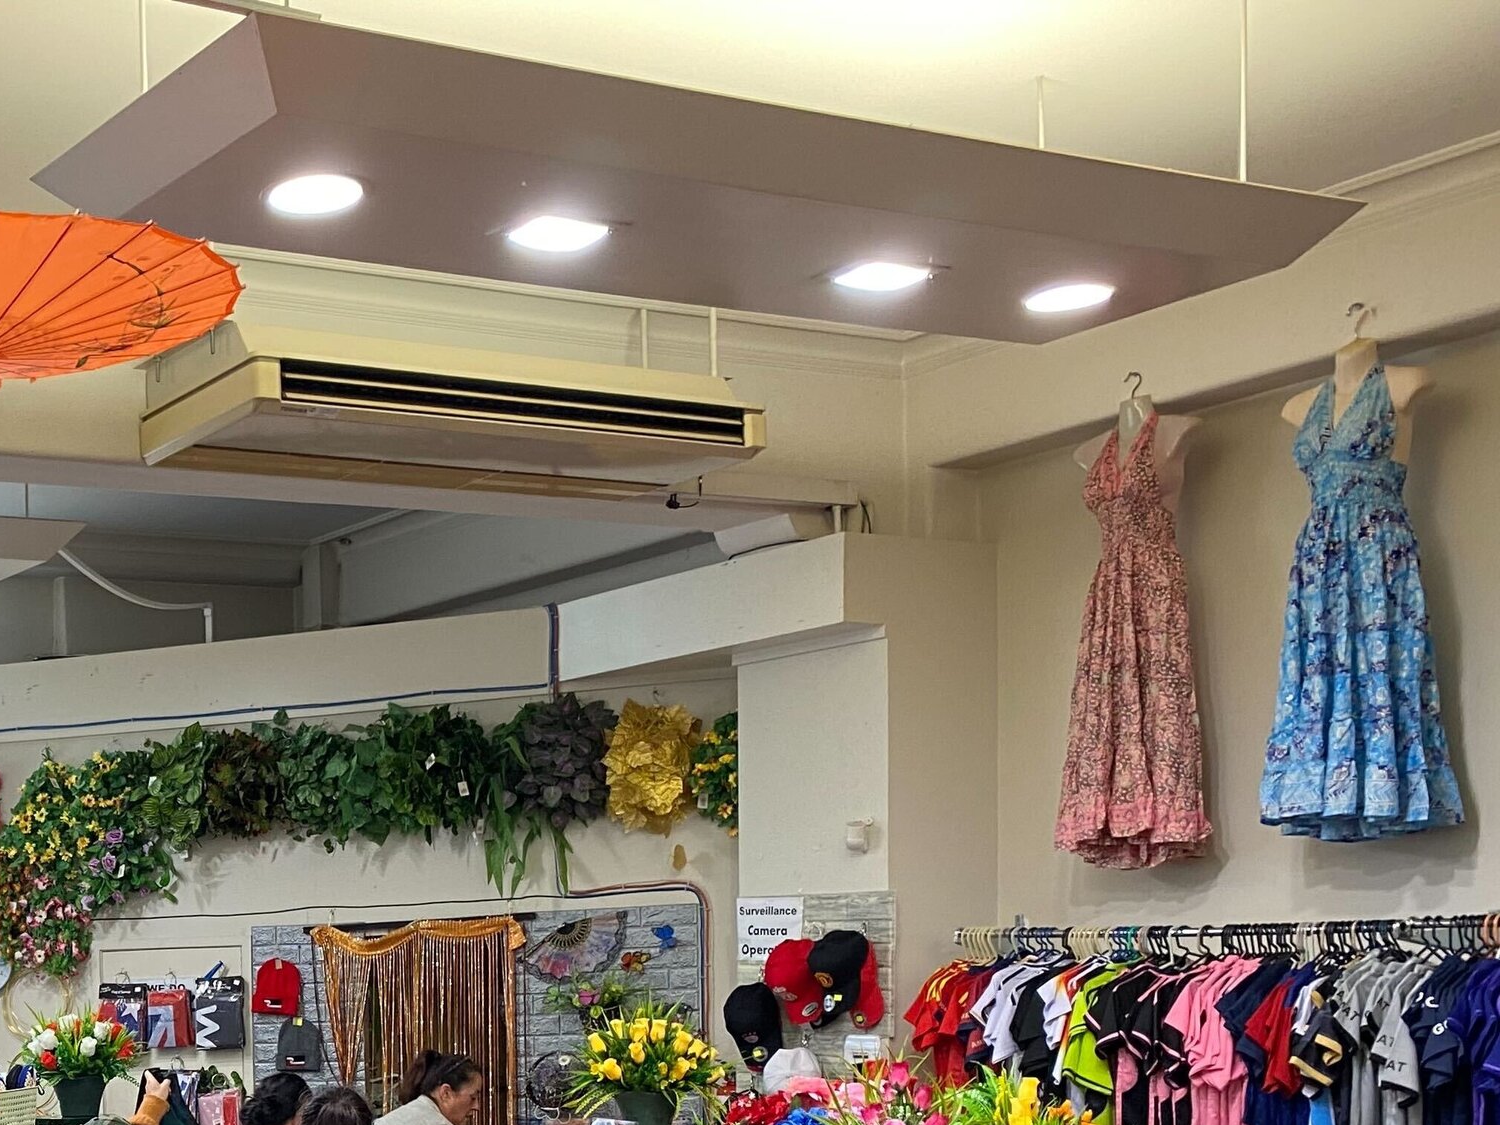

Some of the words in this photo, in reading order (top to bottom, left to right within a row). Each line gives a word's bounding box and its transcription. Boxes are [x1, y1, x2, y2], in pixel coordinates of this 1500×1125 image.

[739, 906, 797, 916] Surveillance
[747, 924, 788, 936] Camera
[741, 944, 776, 957] Opera
